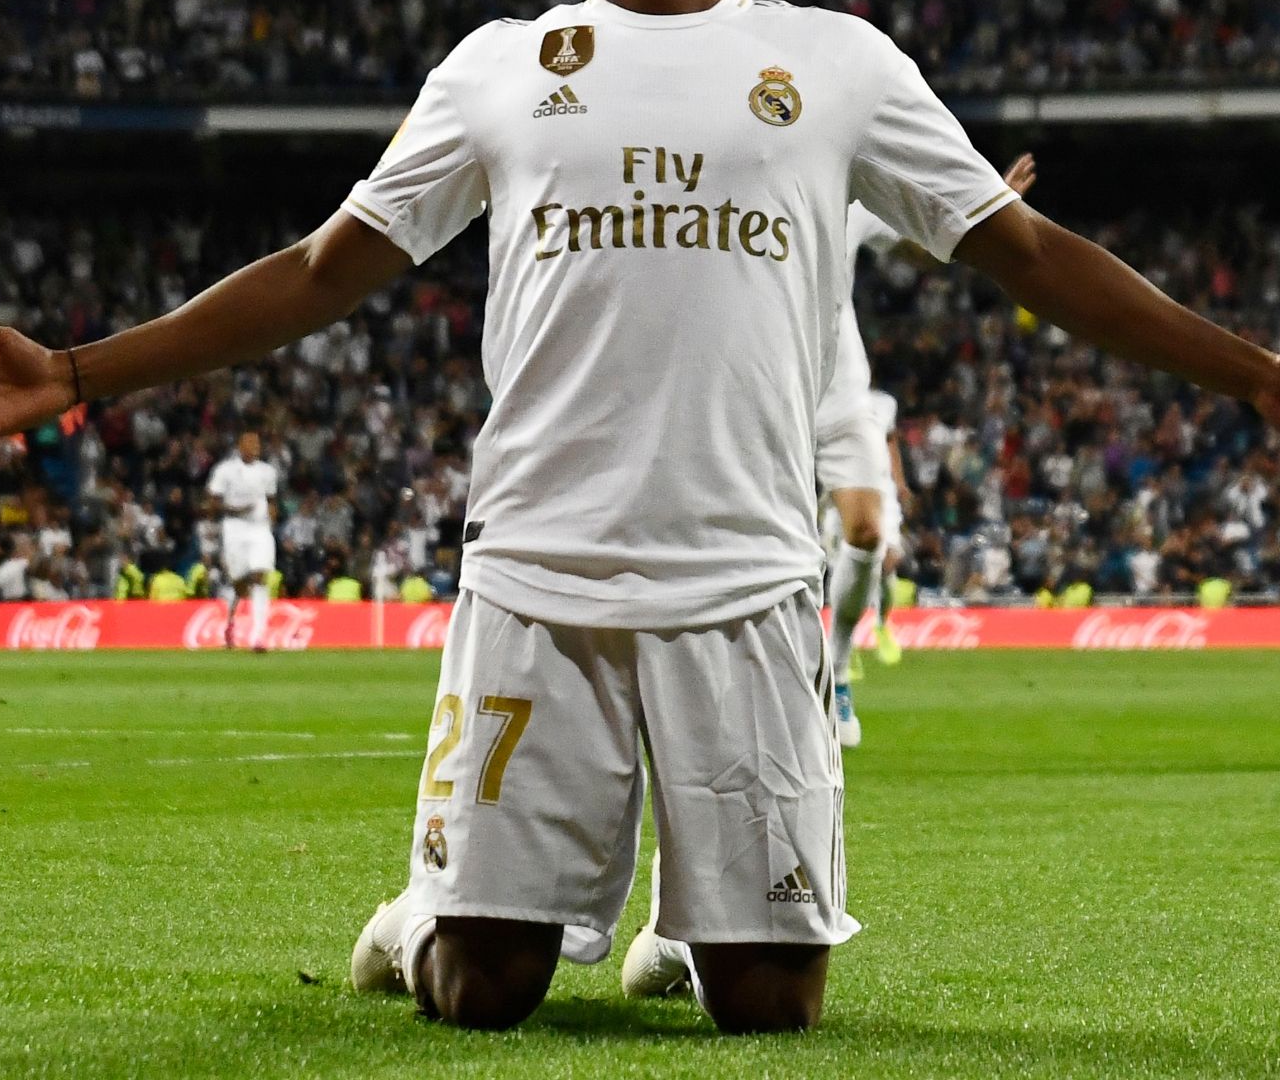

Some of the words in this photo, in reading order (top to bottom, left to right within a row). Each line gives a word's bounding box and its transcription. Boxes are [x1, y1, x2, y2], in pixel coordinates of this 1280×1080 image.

[552, 55, 579, 64] FIFA
[532, 103, 589, 119] adidas
[621, 146, 704, 192] Fly
[531, 190, 791, 262] Emirates
[421, 693, 534, 806] 27
[766, 887, 817, 904] adidas
